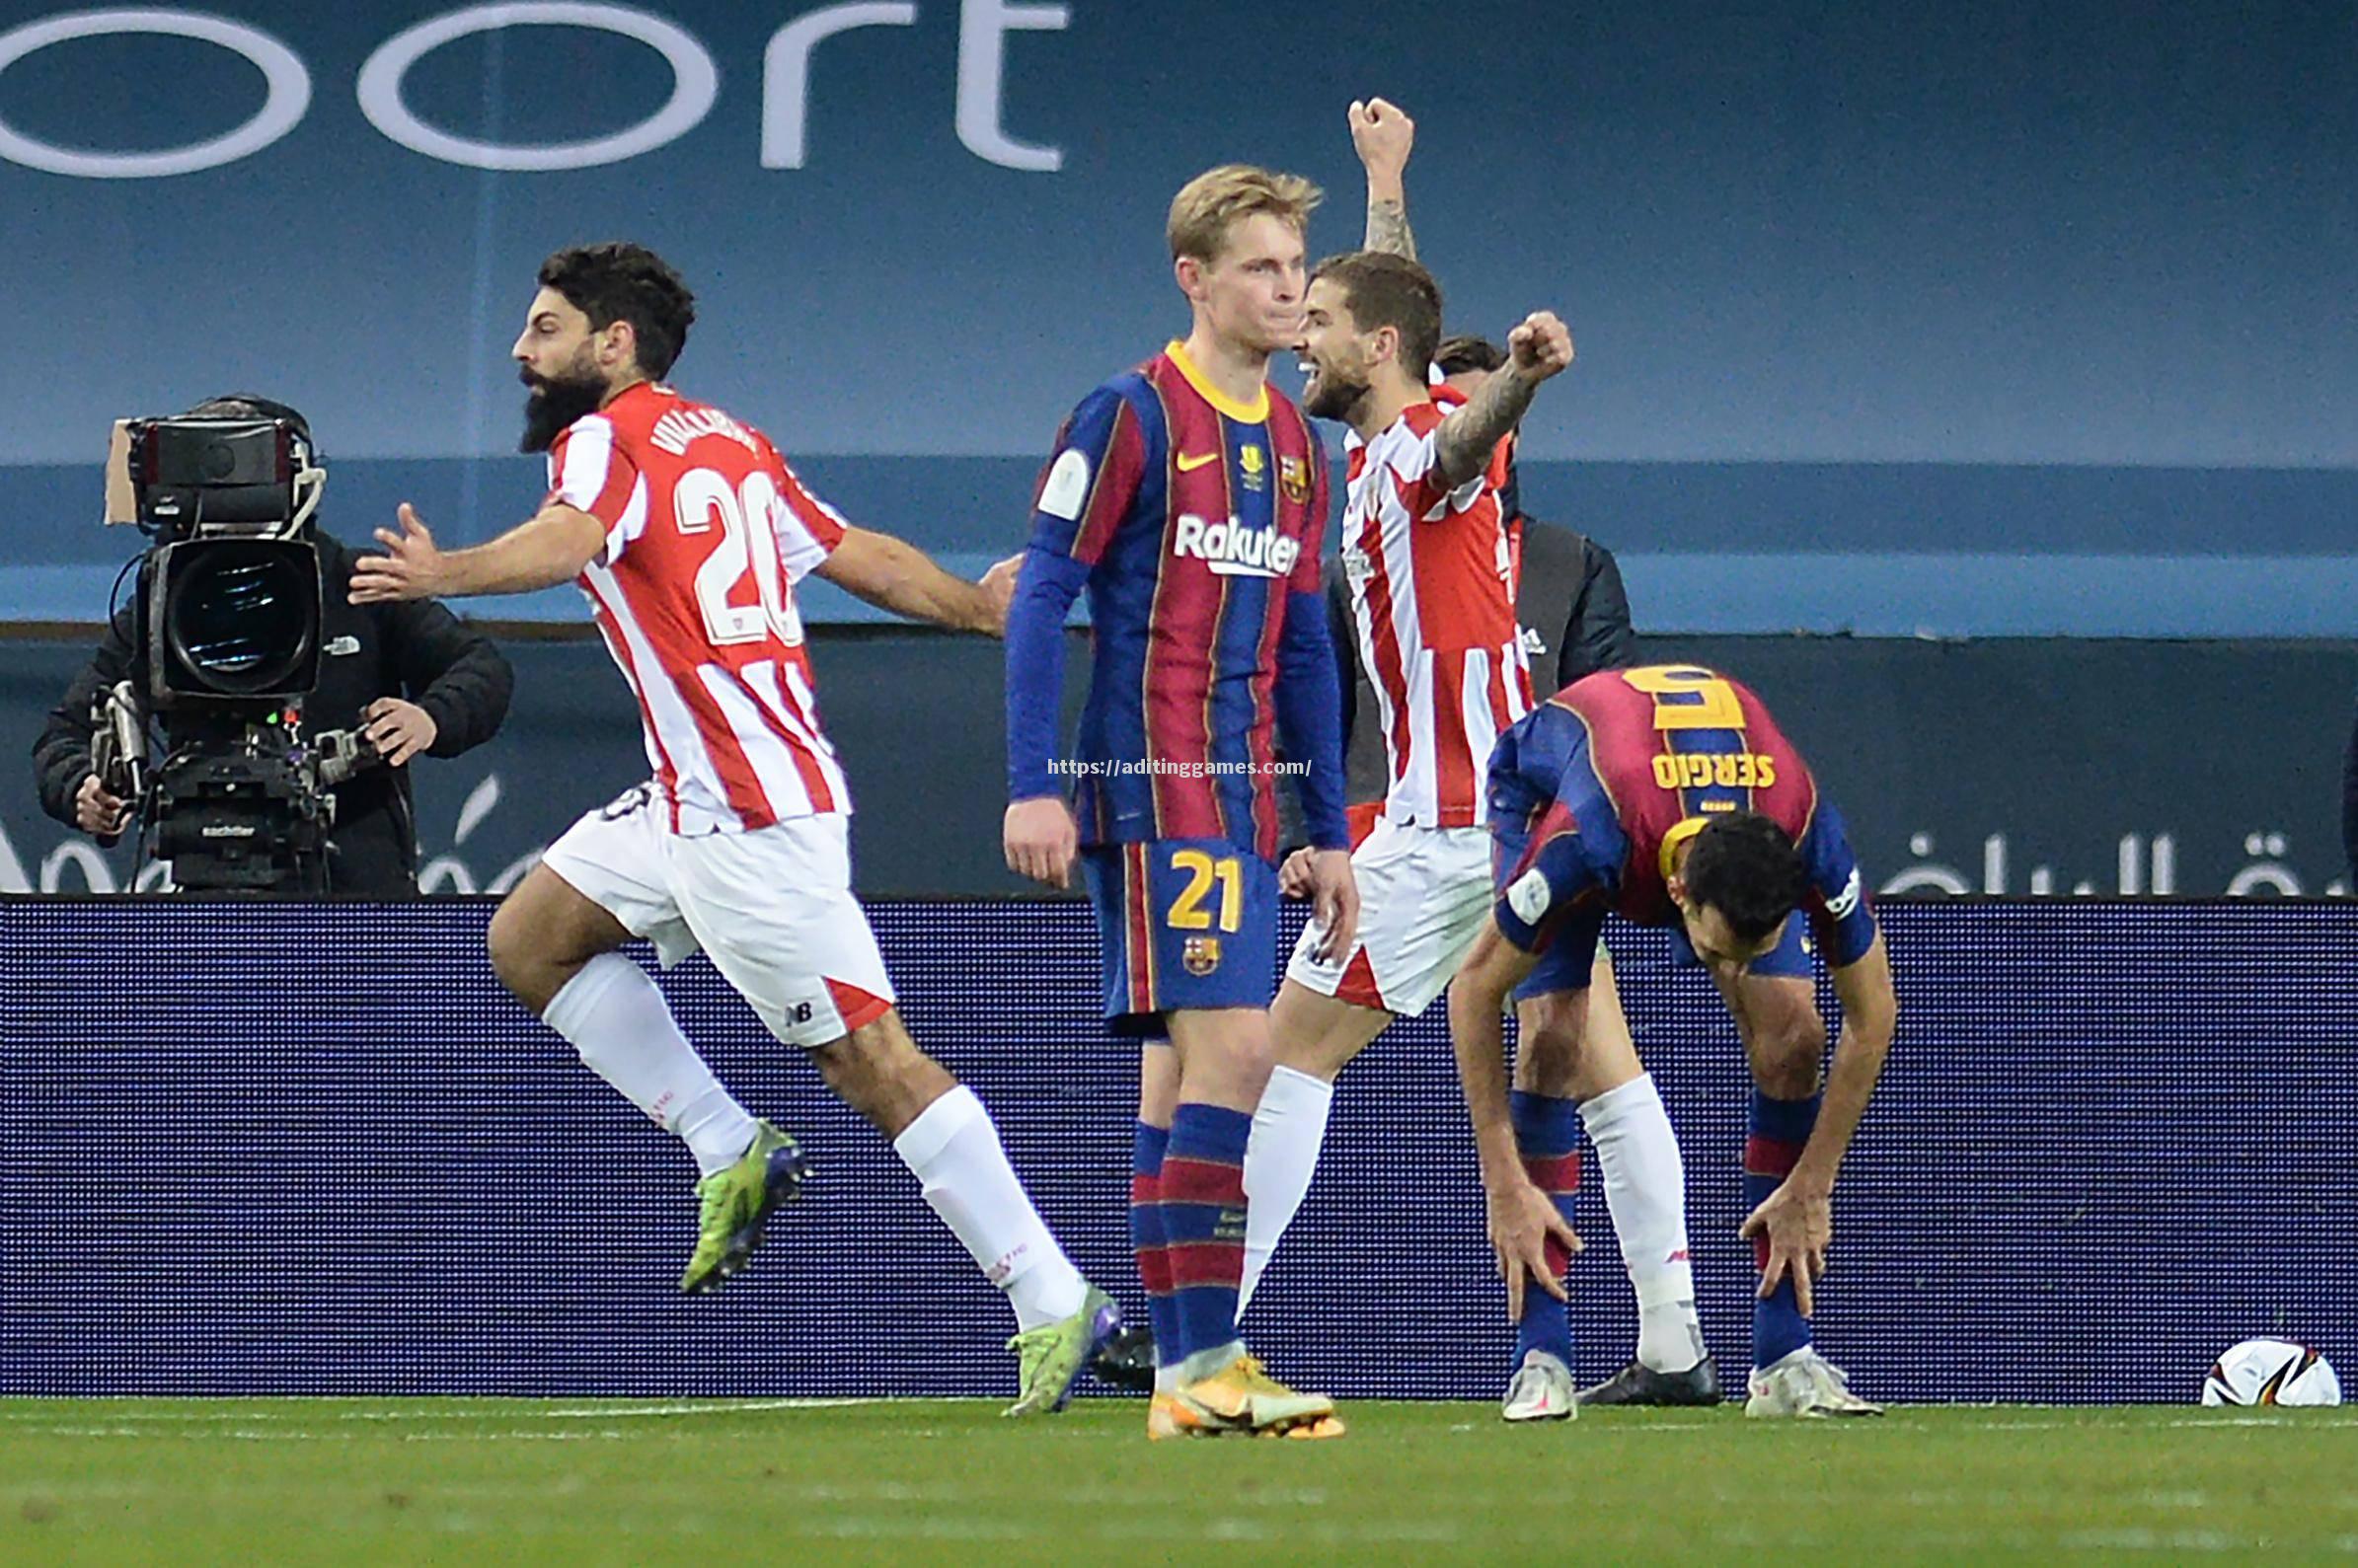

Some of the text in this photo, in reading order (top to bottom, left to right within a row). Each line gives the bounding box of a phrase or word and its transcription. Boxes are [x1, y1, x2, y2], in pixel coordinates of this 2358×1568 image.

[673, 468, 805, 647] 20
[1651, 753, 1776, 788] SERGIO
[1167, 849, 1244, 933] 21
